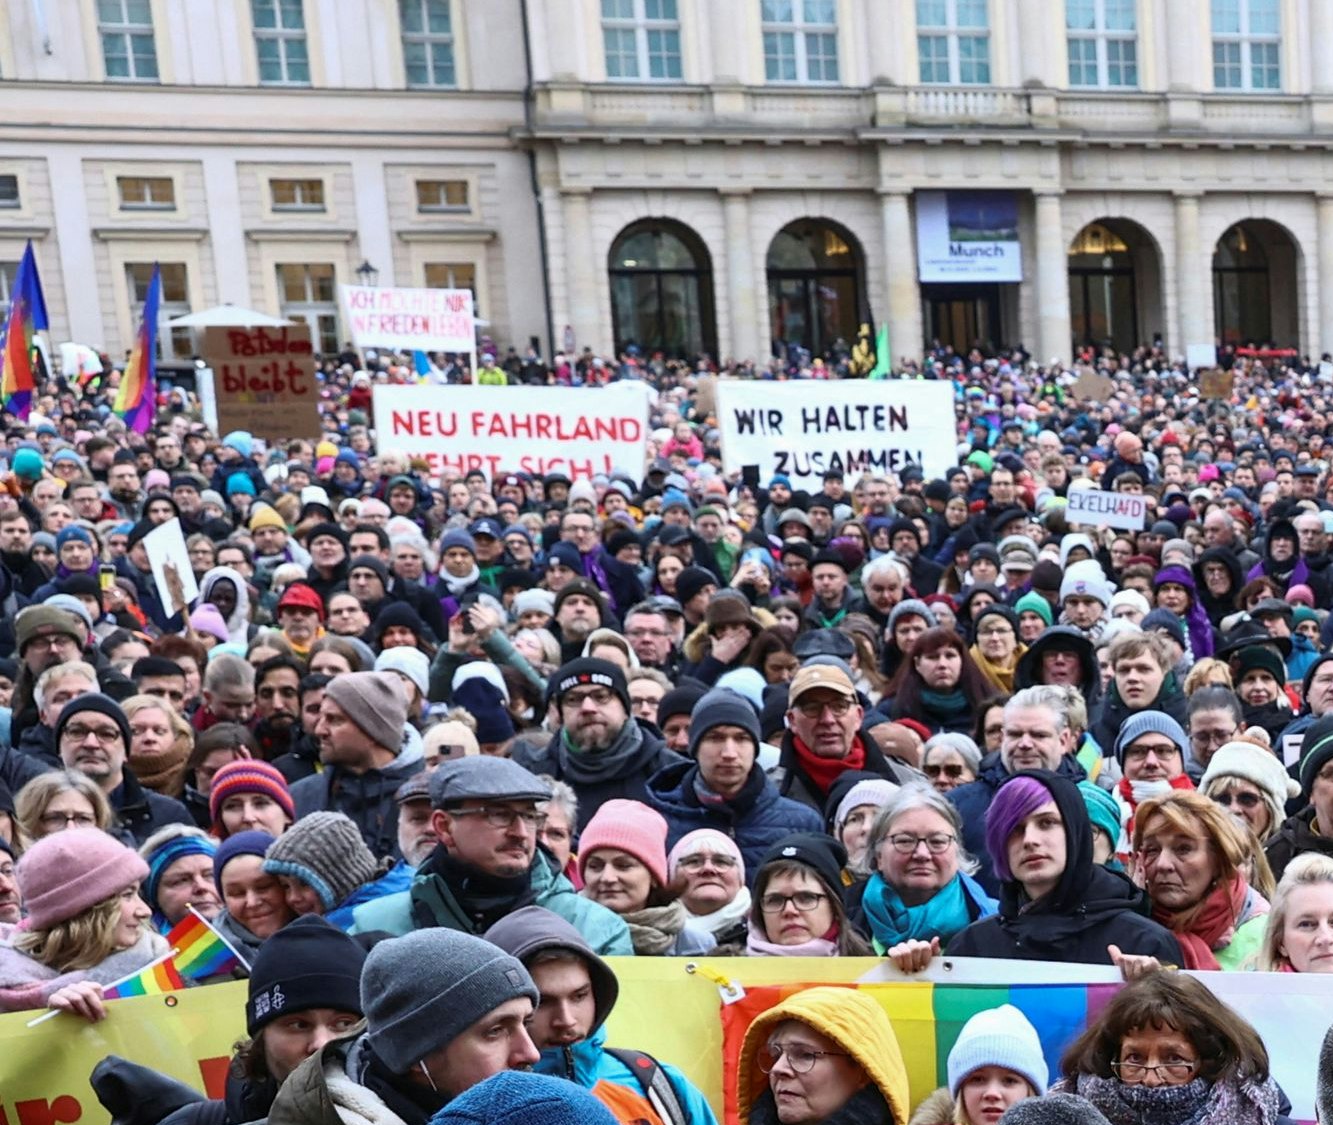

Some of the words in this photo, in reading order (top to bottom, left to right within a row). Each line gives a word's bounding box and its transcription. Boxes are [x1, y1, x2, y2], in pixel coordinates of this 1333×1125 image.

[949, 243, 1004, 257] Munch
[221, 361, 307, 395] bleibt
[392, 410, 459, 437] NEU
[471, 411, 641, 443] FAHRLAND
[734, 407, 783, 436] WIR
[802, 405, 908, 433] HALTEN
